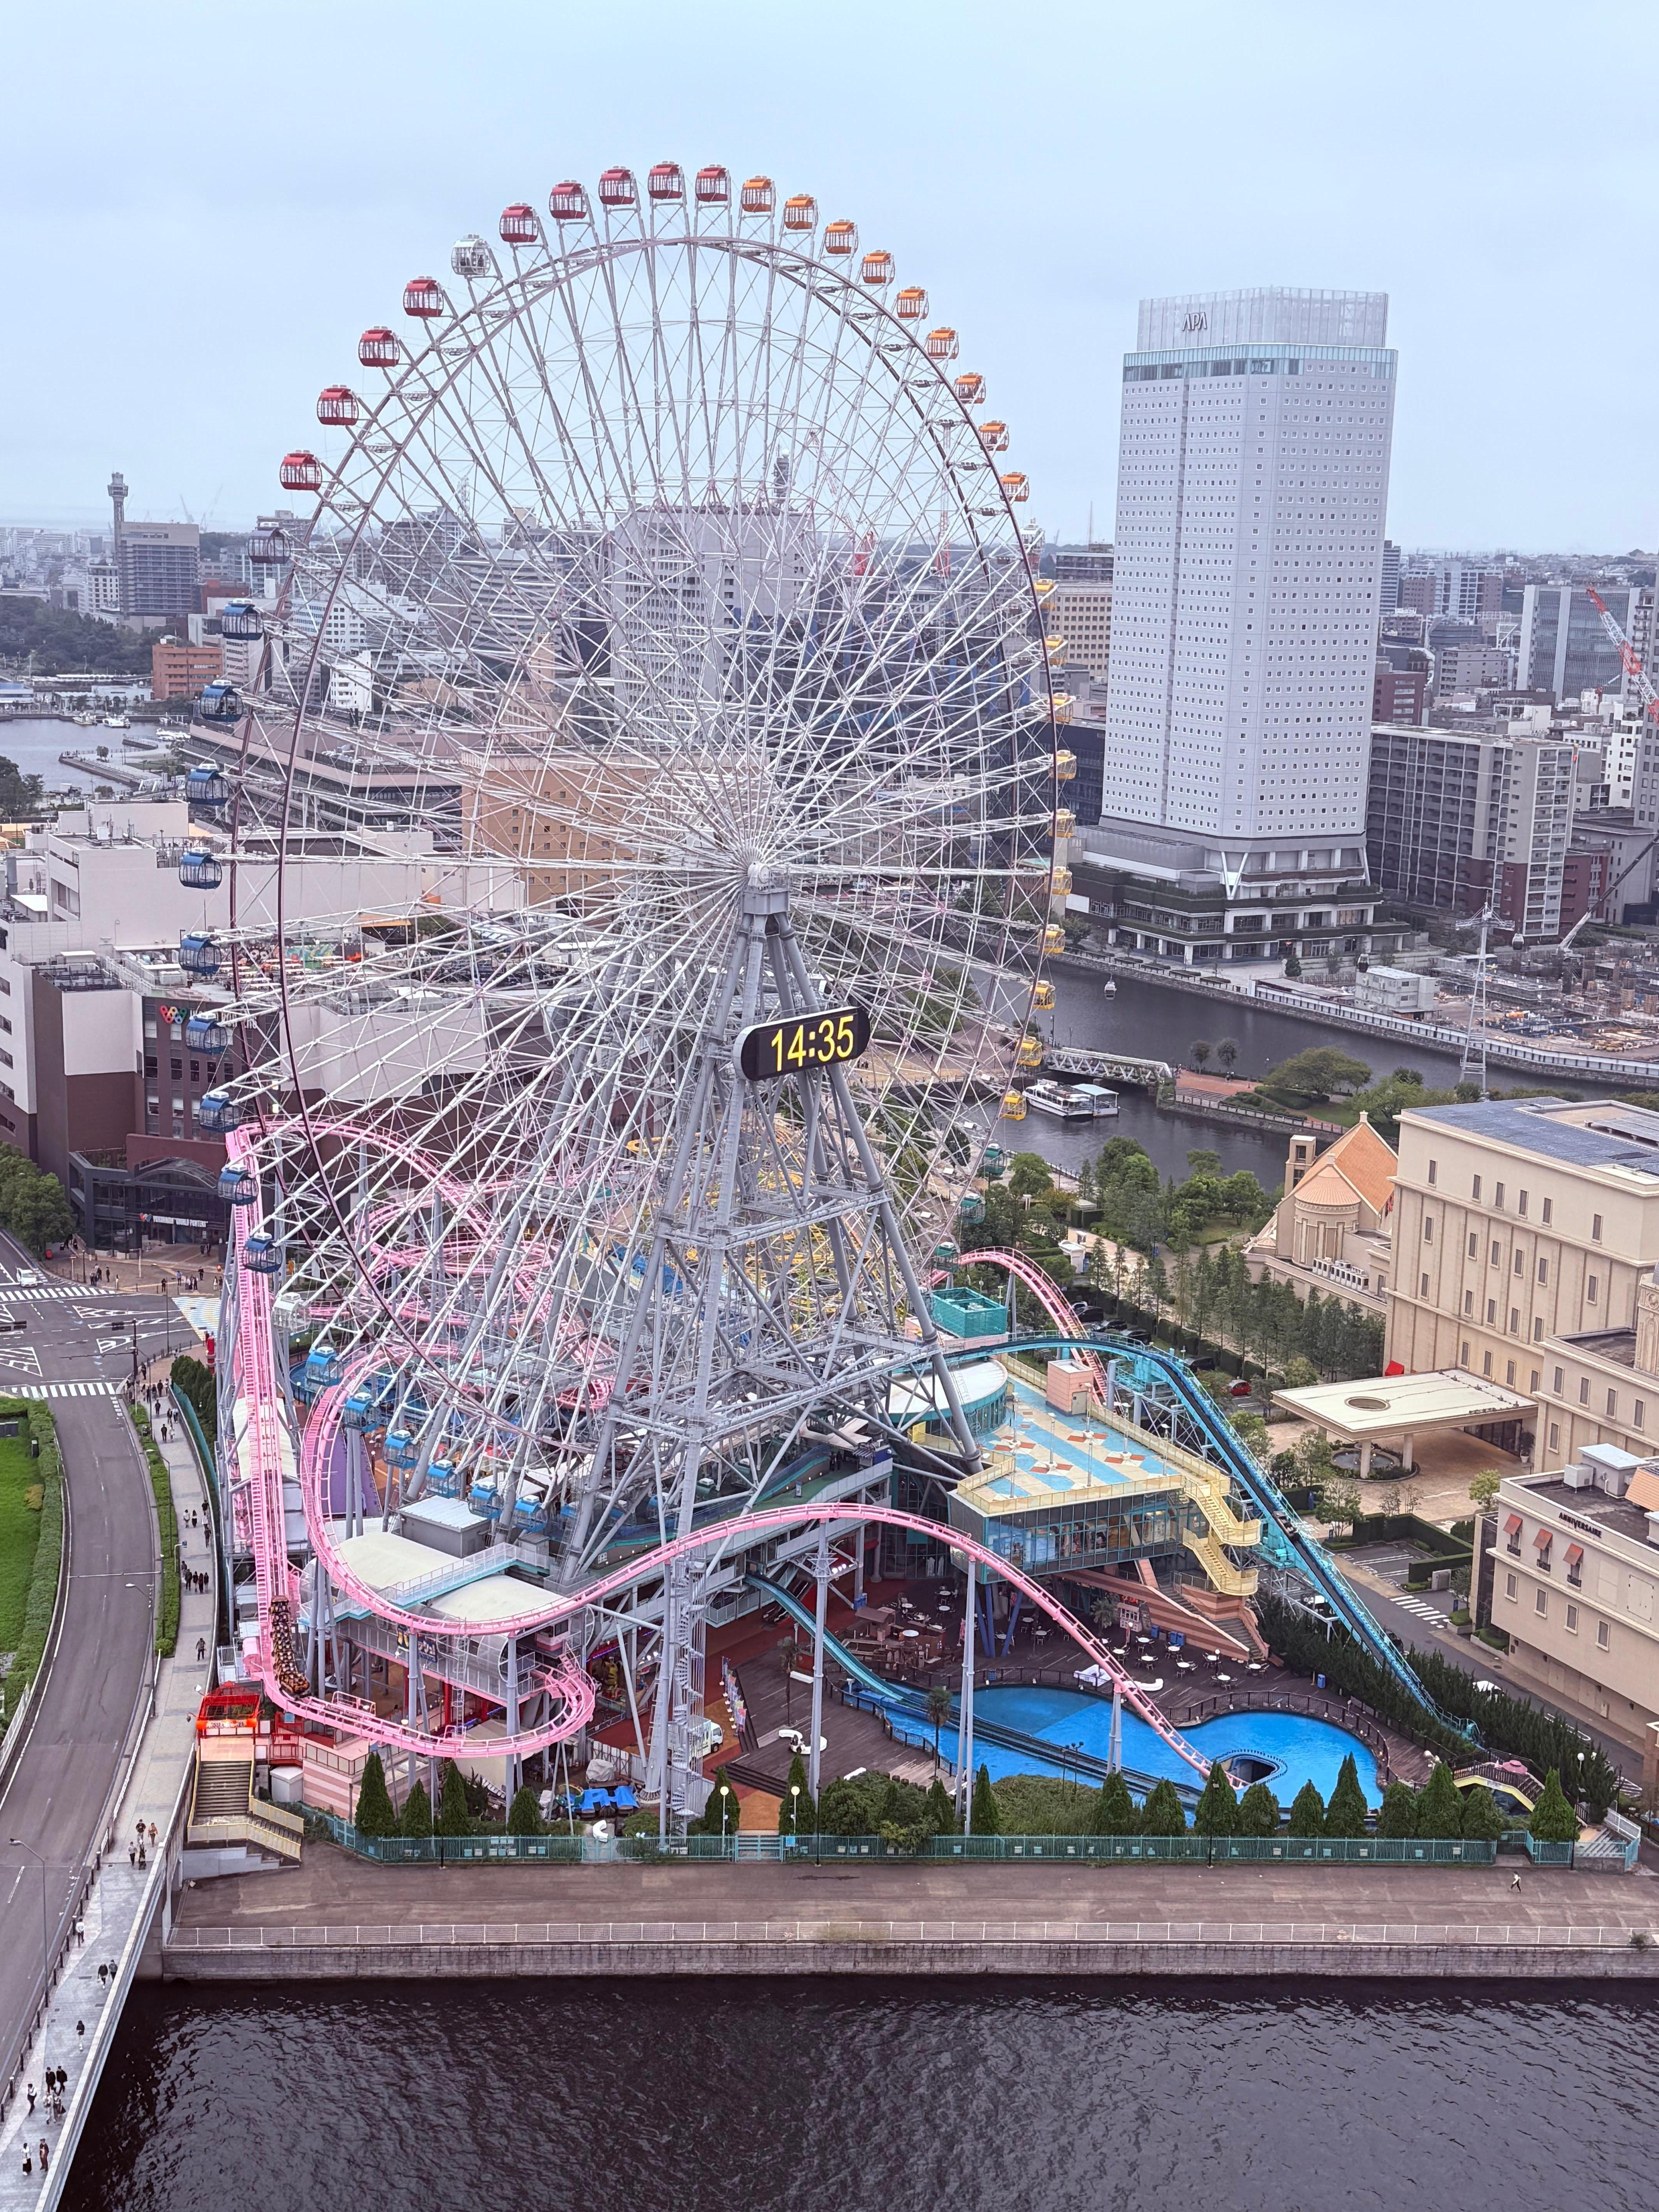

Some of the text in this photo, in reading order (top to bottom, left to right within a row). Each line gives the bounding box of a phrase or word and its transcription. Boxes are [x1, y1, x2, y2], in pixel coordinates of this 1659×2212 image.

[1182, 312, 1207, 331] APA
[771, 1015, 854, 1072] 14:35
[1559, 1512, 1602, 1538] ANNIVERSAIRE
